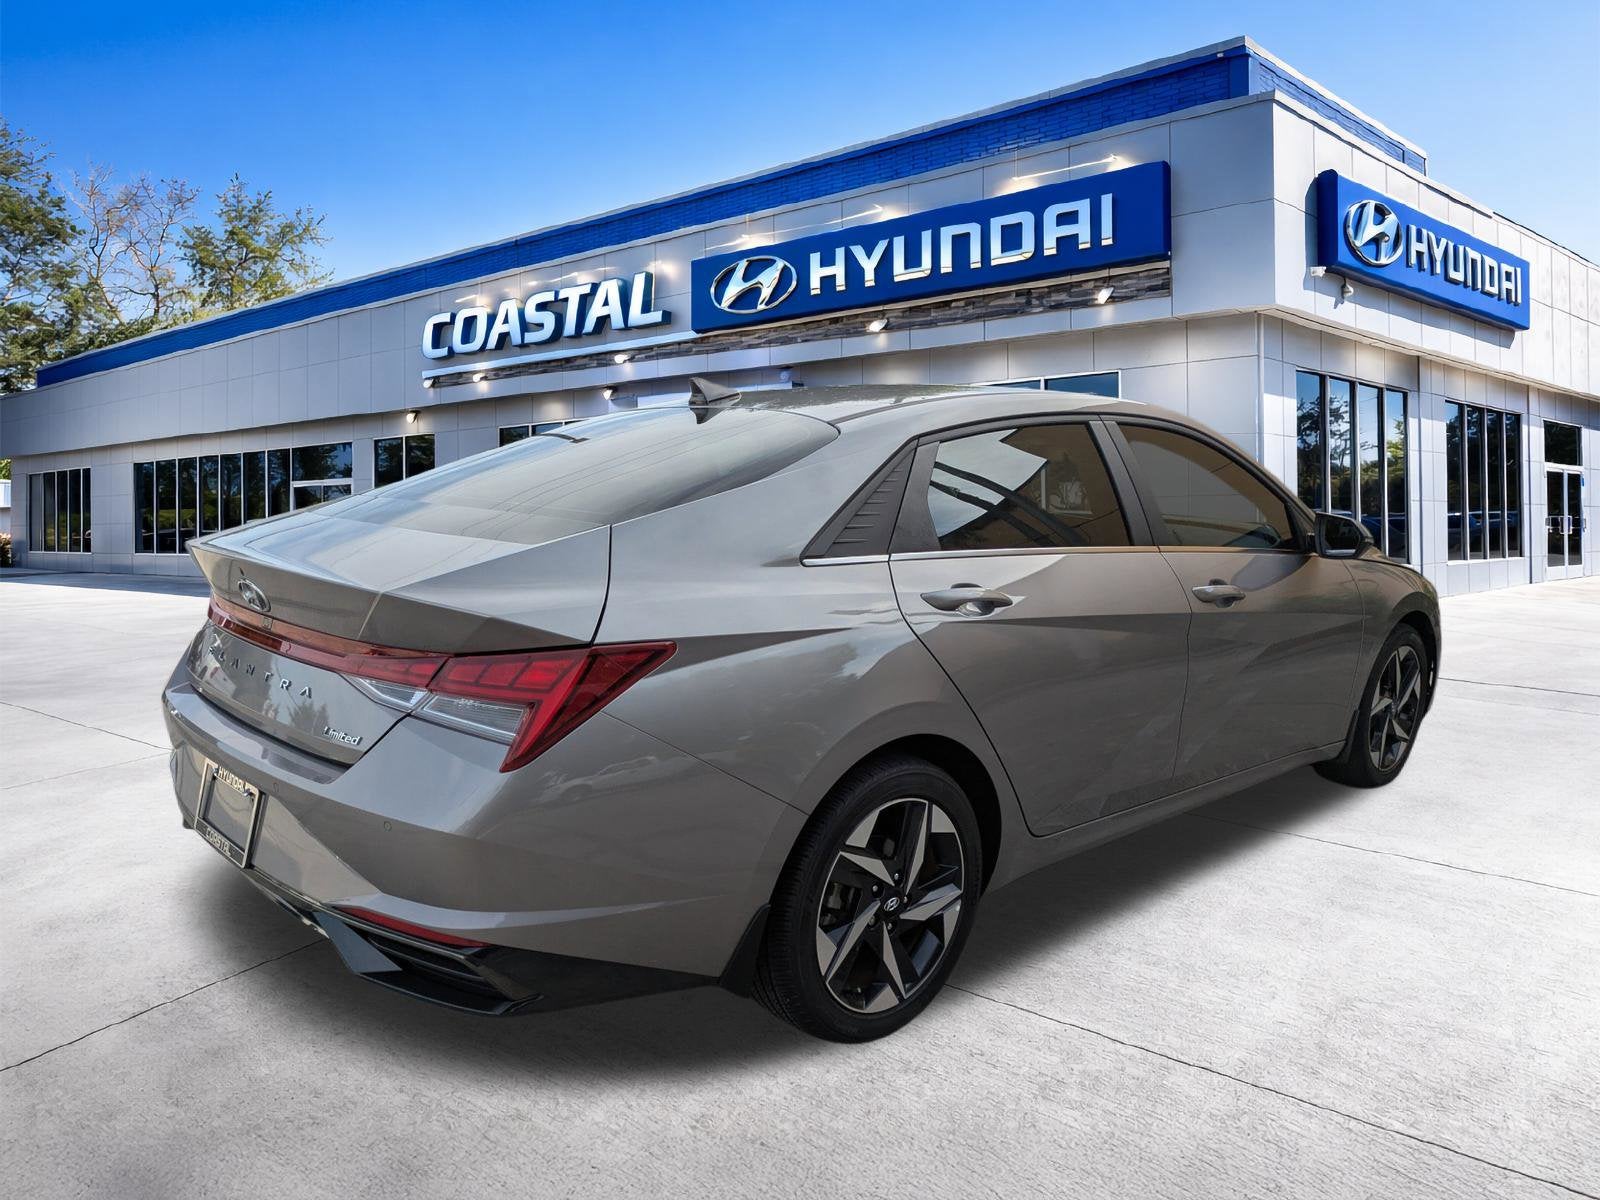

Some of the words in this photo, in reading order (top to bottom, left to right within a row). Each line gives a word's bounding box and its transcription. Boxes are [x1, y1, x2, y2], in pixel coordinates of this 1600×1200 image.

[810, 193, 1113, 295] HYUNDAI
[1406, 224, 1522, 305] HYUNDAI
[422, 271, 668, 359] COASTAL
[323, 725, 362, 746] Limited
